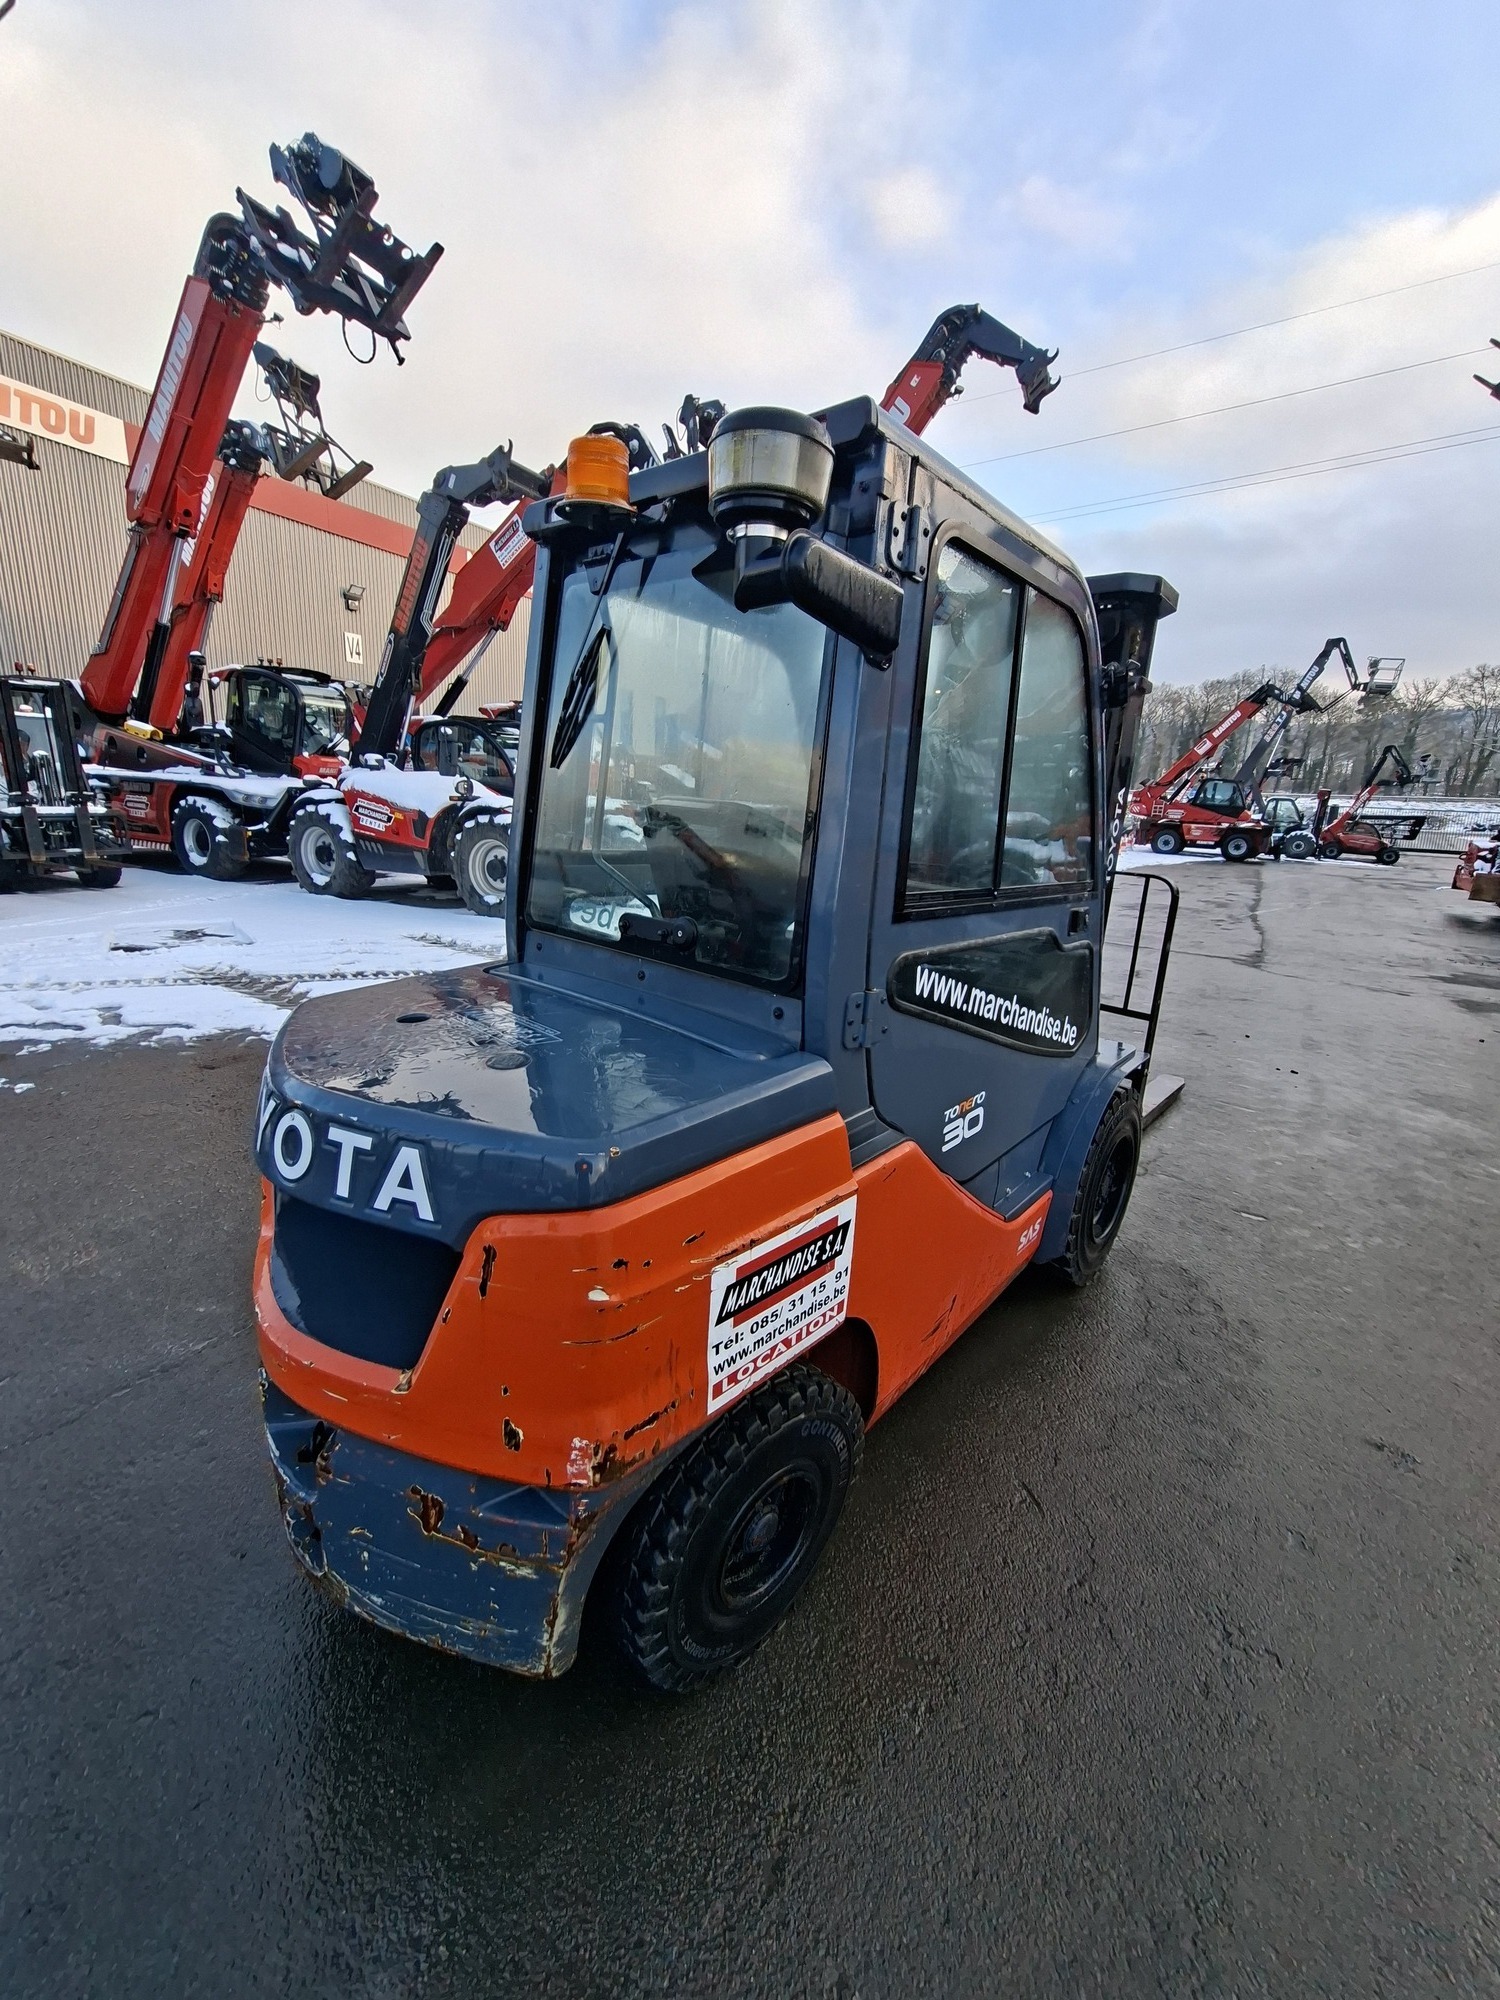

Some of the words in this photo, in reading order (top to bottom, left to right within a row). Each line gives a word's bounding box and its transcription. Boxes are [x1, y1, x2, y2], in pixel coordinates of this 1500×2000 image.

[148, 311, 193, 443] MANITOU
[181, 473, 215, 567] MAOU
[394, 536, 428, 635] MANITOU
[346, 636, 362, 661] V4
[1293, 665, 1320, 700] MNITOU
[1212, 710, 1242, 738] MANITOU
[361, 817, 385, 830] RENTAL
[915, 965, 1078, 1046] www.marchandise.be
[941, 1106, 984, 1152] 30
[722, 1240, 823, 1317] MARCHANDISE
[822, 1229, 843, 1261] S.A.
[1017, 1217, 1042, 1252] SAS
[712, 1331, 744, 1356] Tél:
[750, 1306, 783, 1334] 085/
[788, 1294, 804, 1313] 31
[811, 1280, 827, 1298] 15
[835, 1266, 849, 1284] 91
[713, 1285, 846, 1376] www.marchandise.be
[722, 1304, 839, 1393] LOCATION
